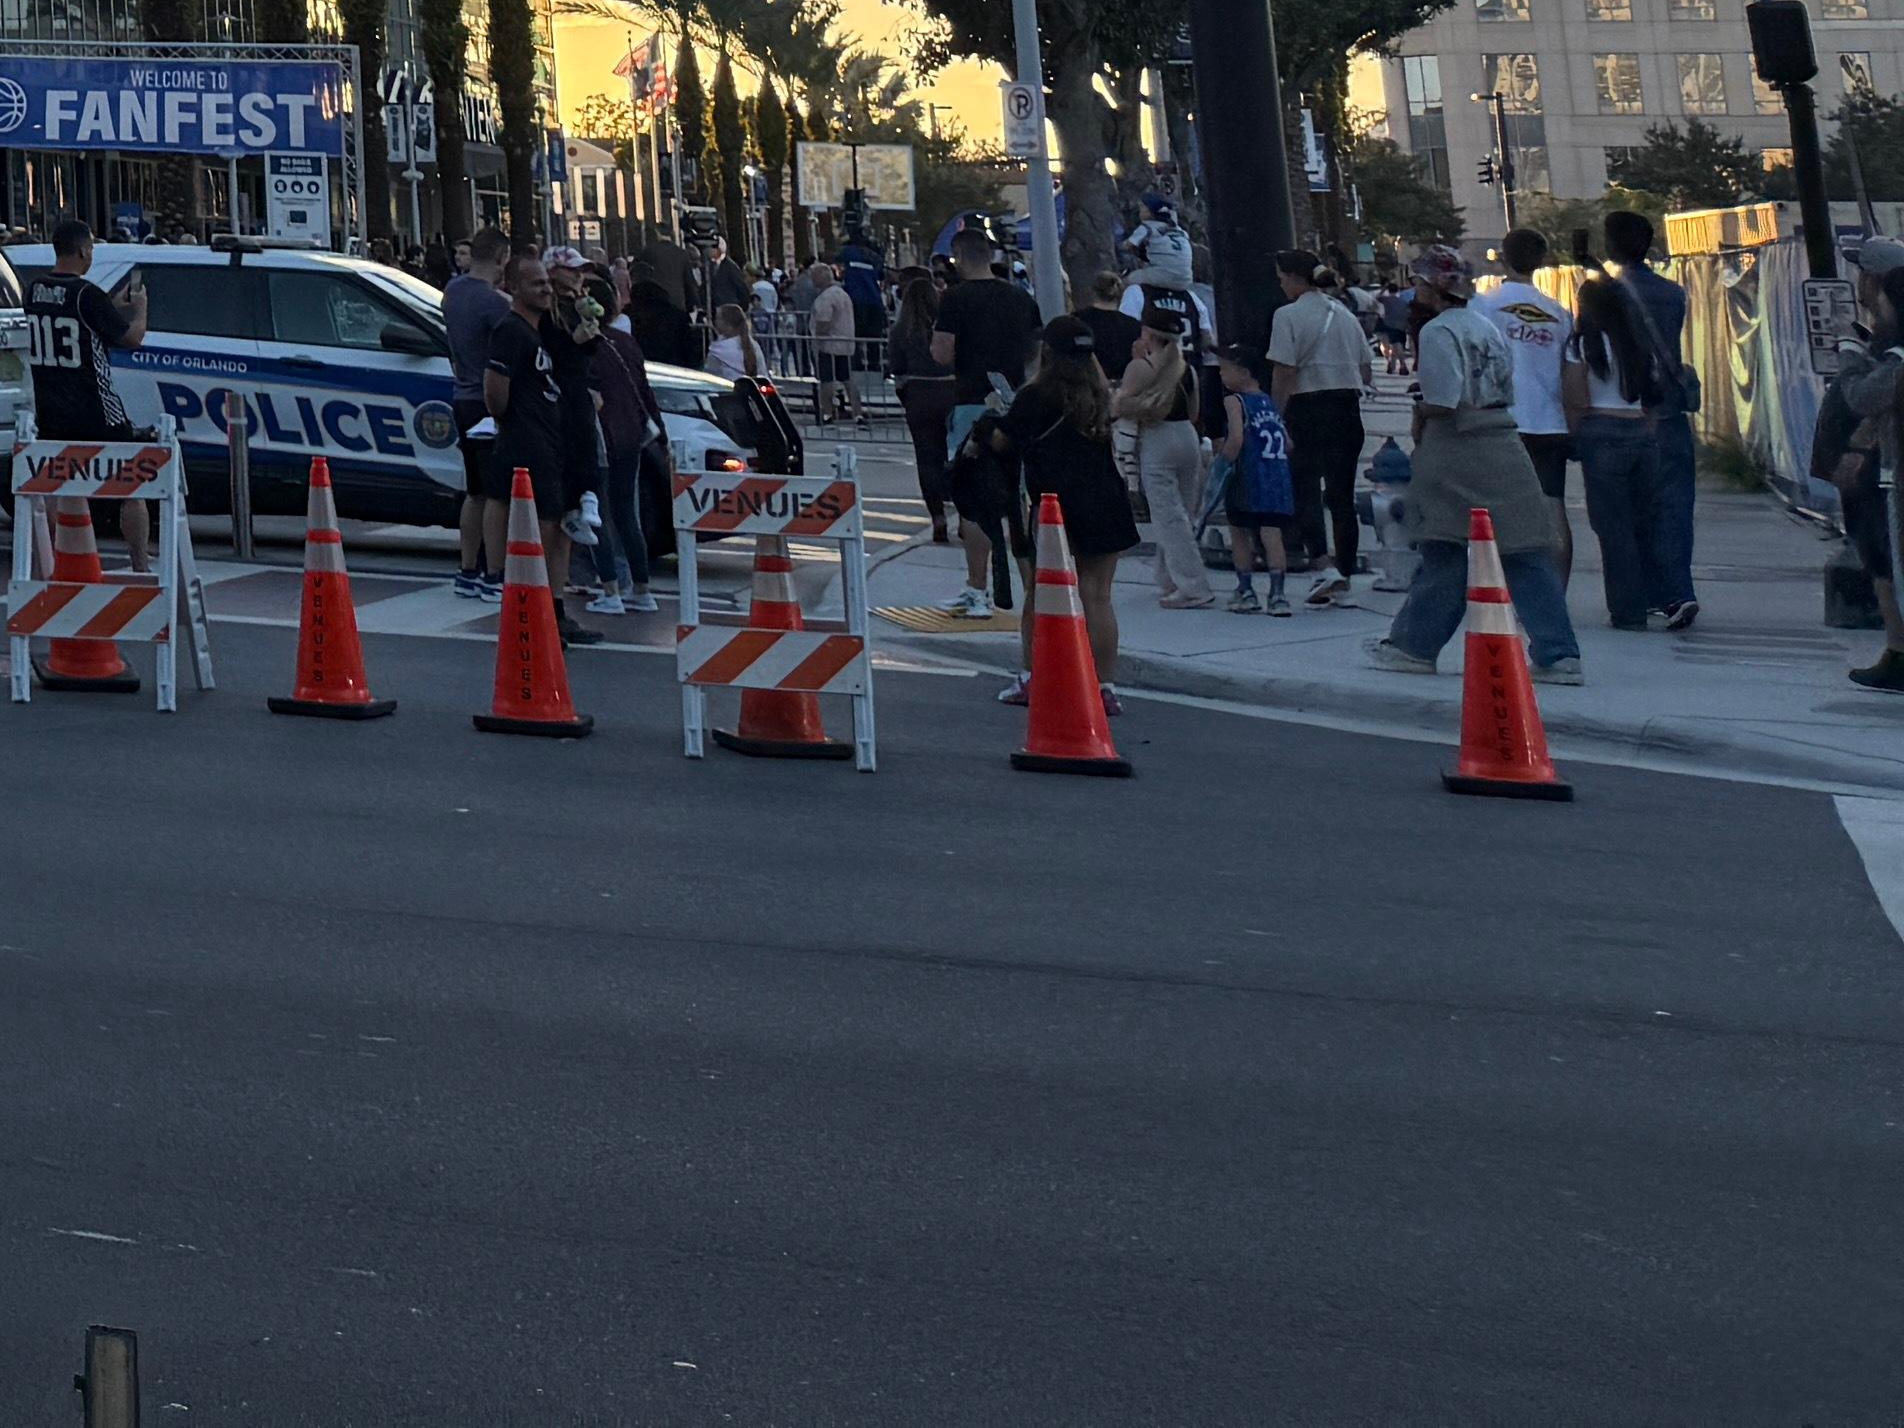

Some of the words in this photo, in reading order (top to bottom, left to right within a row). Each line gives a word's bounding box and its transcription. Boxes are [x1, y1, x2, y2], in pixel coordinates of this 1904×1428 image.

[129, 69, 207, 90] WELCOME
[208, 71, 228, 90] TO
[44, 89, 316, 148] FANFEST
[131, 351, 160, 366] CITY
[162, 354, 181, 366] OF
[182, 356, 248, 374] ORLANDO
[156, 381, 417, 458] POLICE
[1259, 430, 1288, 460] 22
[26, 455, 159, 483] VENUES
[686, 486, 842, 520] VENUES
[313, 575, 324, 682] VENUES
[517, 590, 532, 700] VENUES
[1487, 643, 1513, 761] VENUES
